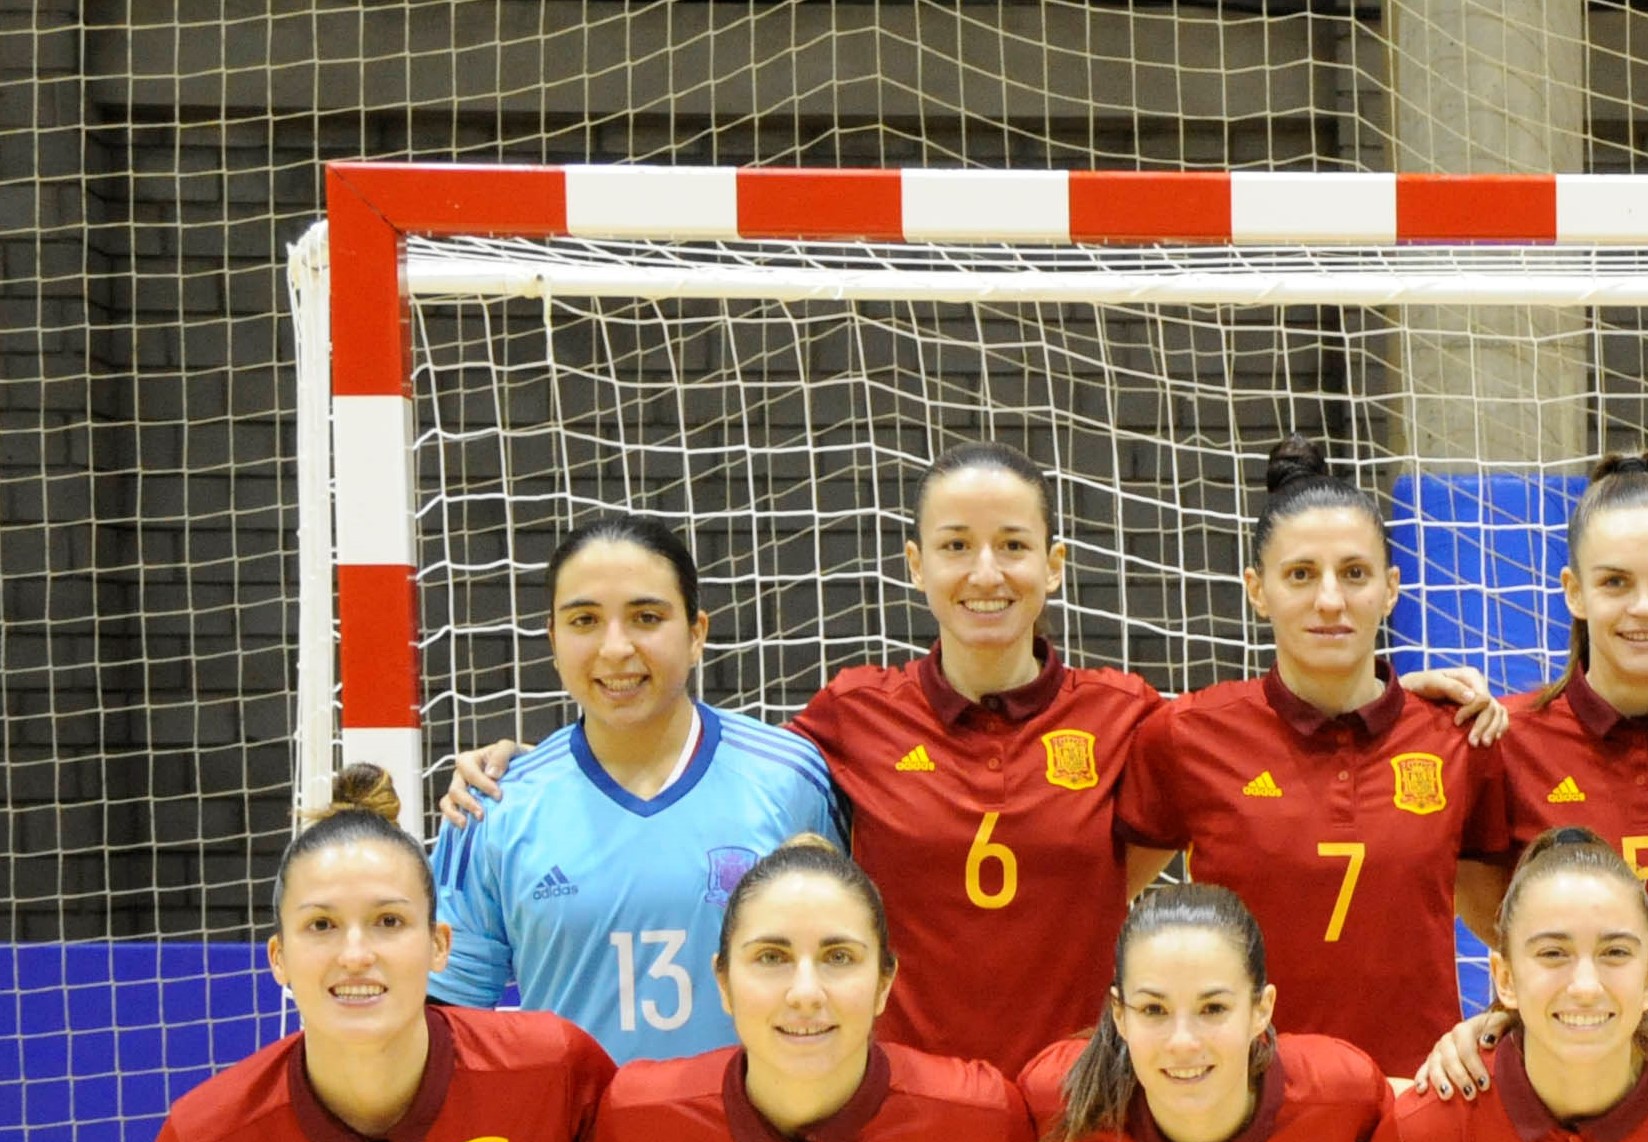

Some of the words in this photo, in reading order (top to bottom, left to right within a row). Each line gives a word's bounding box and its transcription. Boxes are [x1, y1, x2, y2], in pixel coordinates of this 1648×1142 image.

[895, 761, 935, 772] adidas
[1242, 786, 1283, 797] adidas
[1547, 792, 1585, 804] adidas
[965, 812, 1017, 909] 6
[532, 883, 578, 901] adidas
[1318, 843, 1365, 942] 7
[609, 929, 694, 1032] 13
